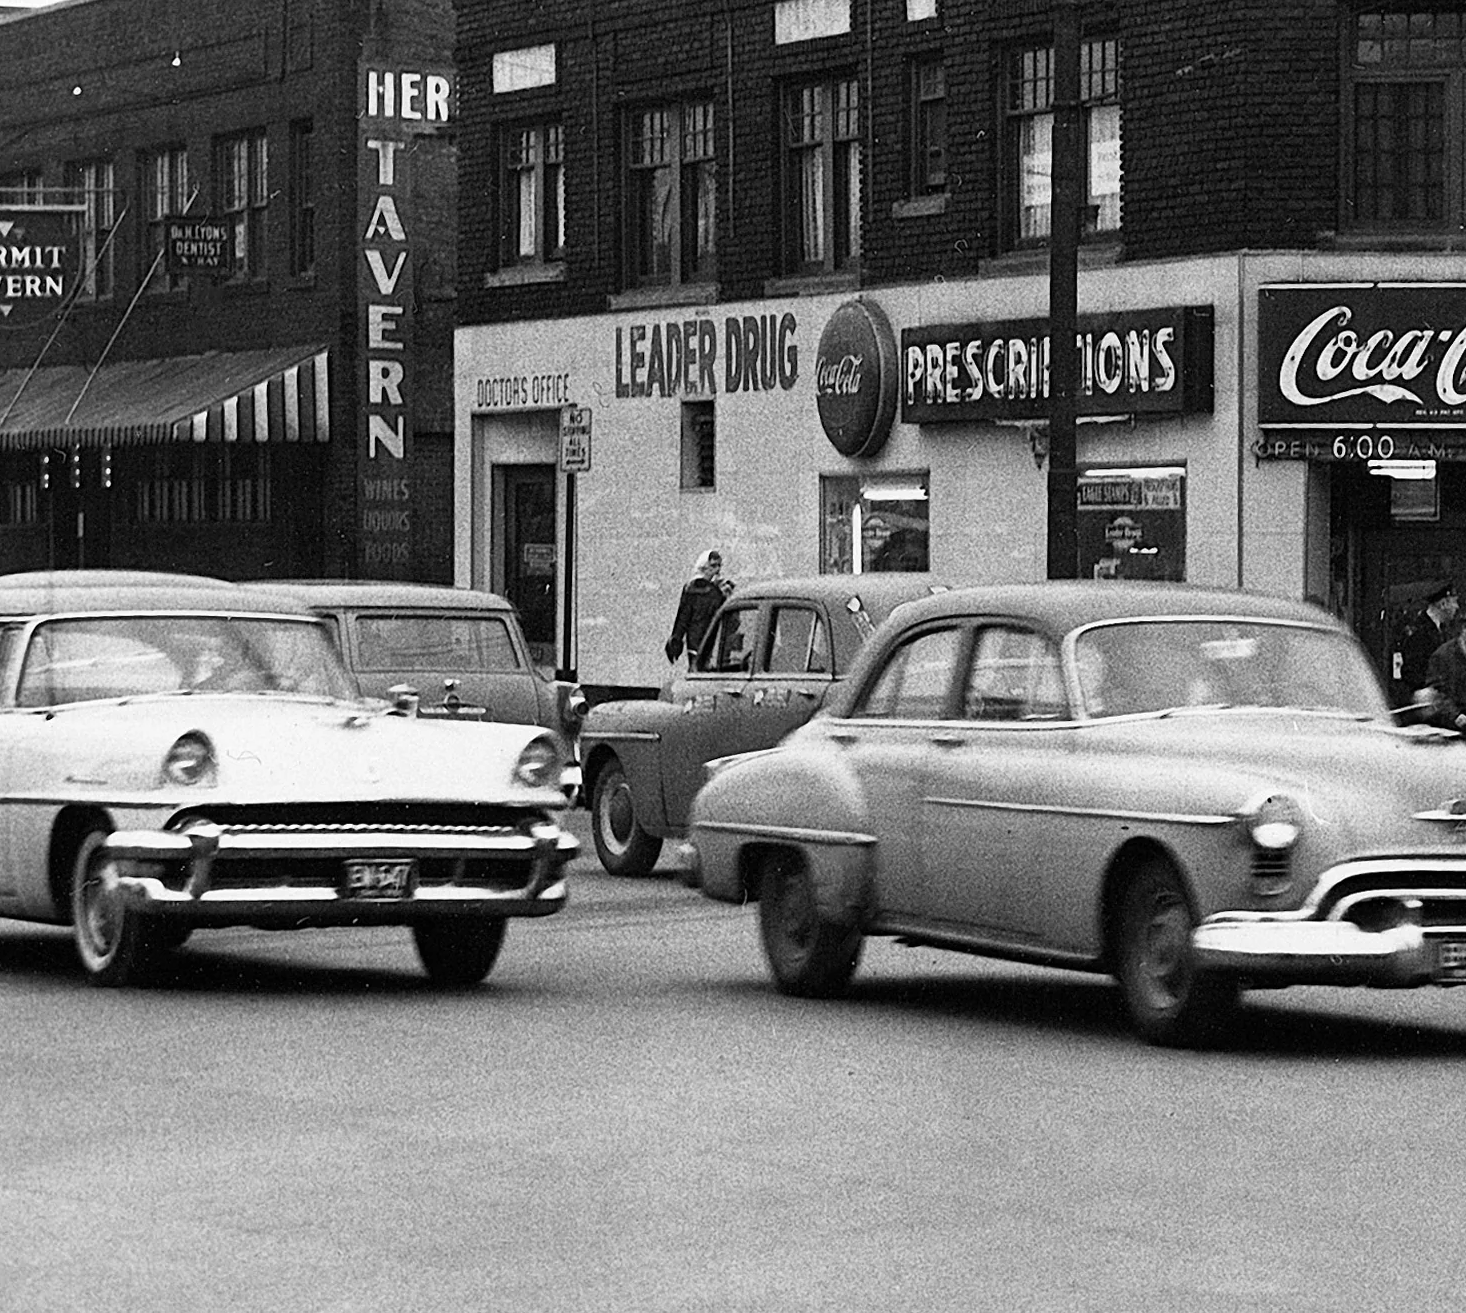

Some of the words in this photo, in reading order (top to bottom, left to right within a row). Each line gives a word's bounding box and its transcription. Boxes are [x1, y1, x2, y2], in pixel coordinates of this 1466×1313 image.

[367, 72, 451, 121] HER
[175, 240, 222, 256] DENTIST
[366, 139, 405, 459] TAVERN
[615, 317, 717, 399] LEADER
[724, 311, 798, 393] DRUG
[906, 327, 1176, 406] PRESCRIIONS
[532, 374, 569, 403] OFFICE
[1255, 441, 1319, 458] OPEN
[1332, 435, 1394, 459] 6:00
[364, 479, 409, 500] WINES
